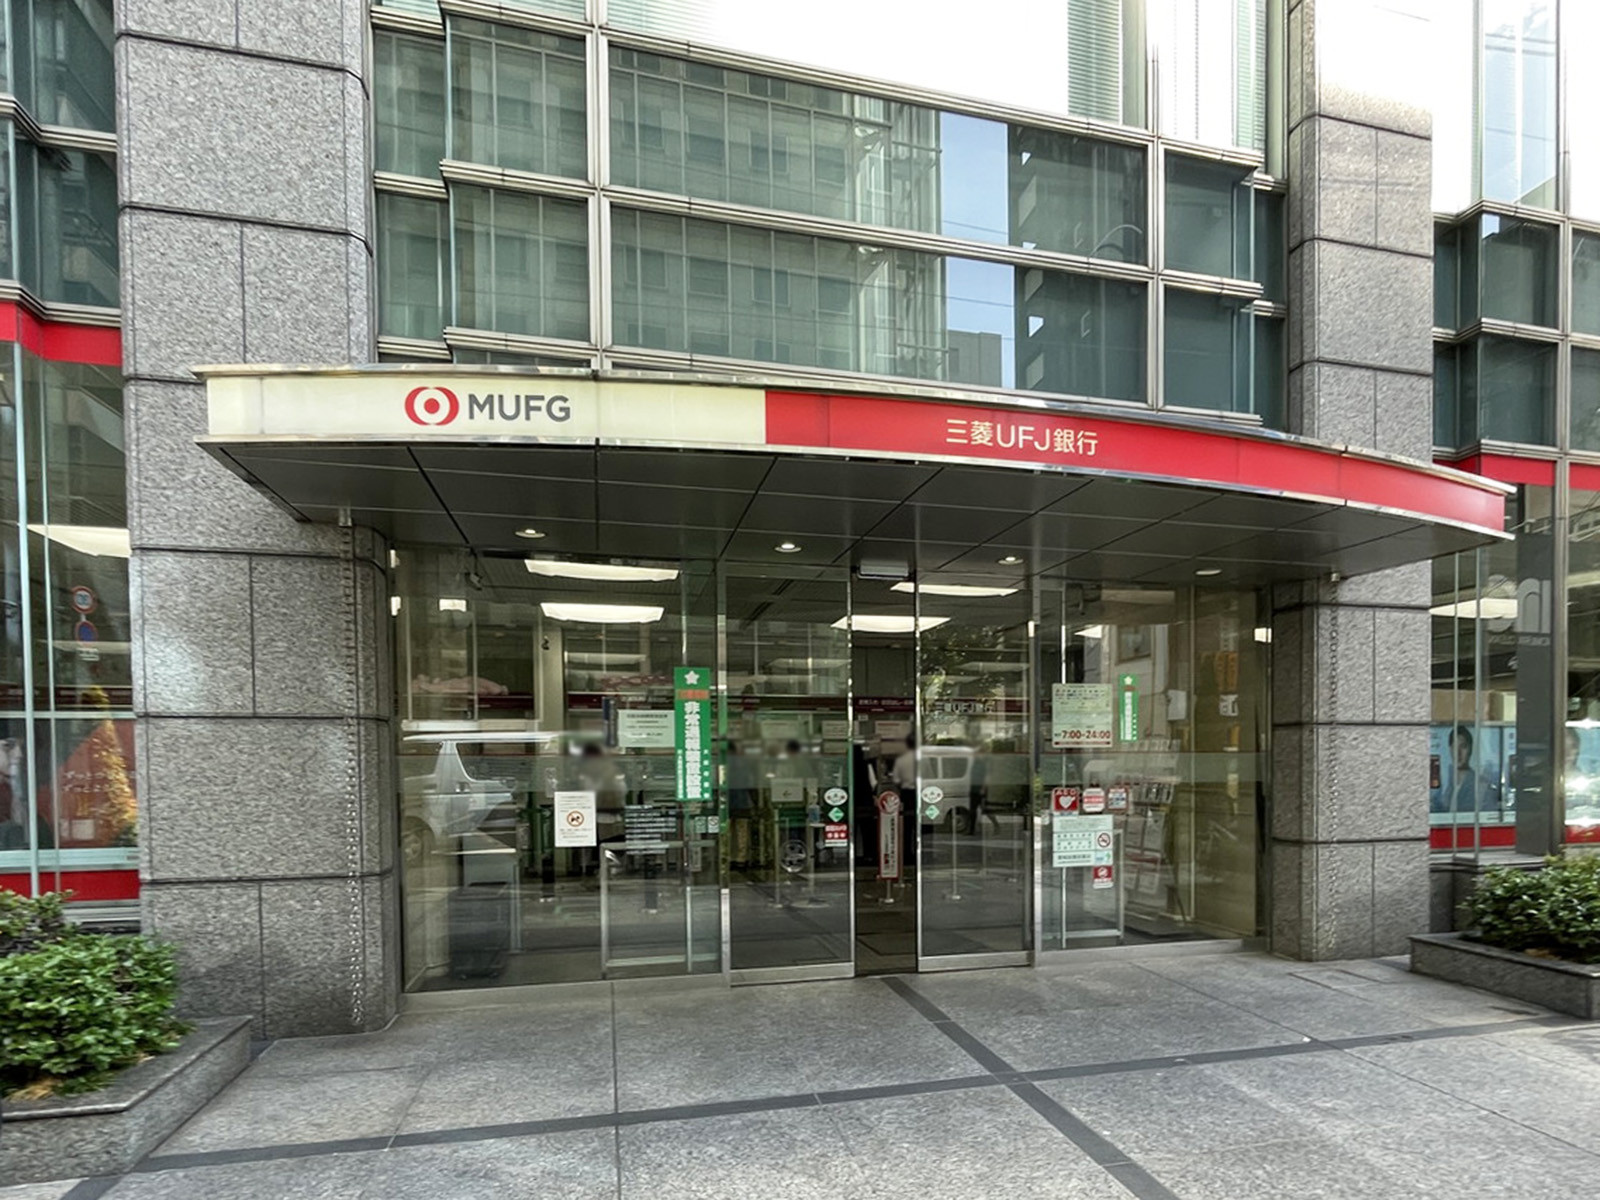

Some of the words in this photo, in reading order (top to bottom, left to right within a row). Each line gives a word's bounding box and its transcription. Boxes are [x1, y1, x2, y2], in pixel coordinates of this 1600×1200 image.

[469, 394, 571, 422] MUFG
[945, 418, 1098, 456] 三菱UFJ銀行
